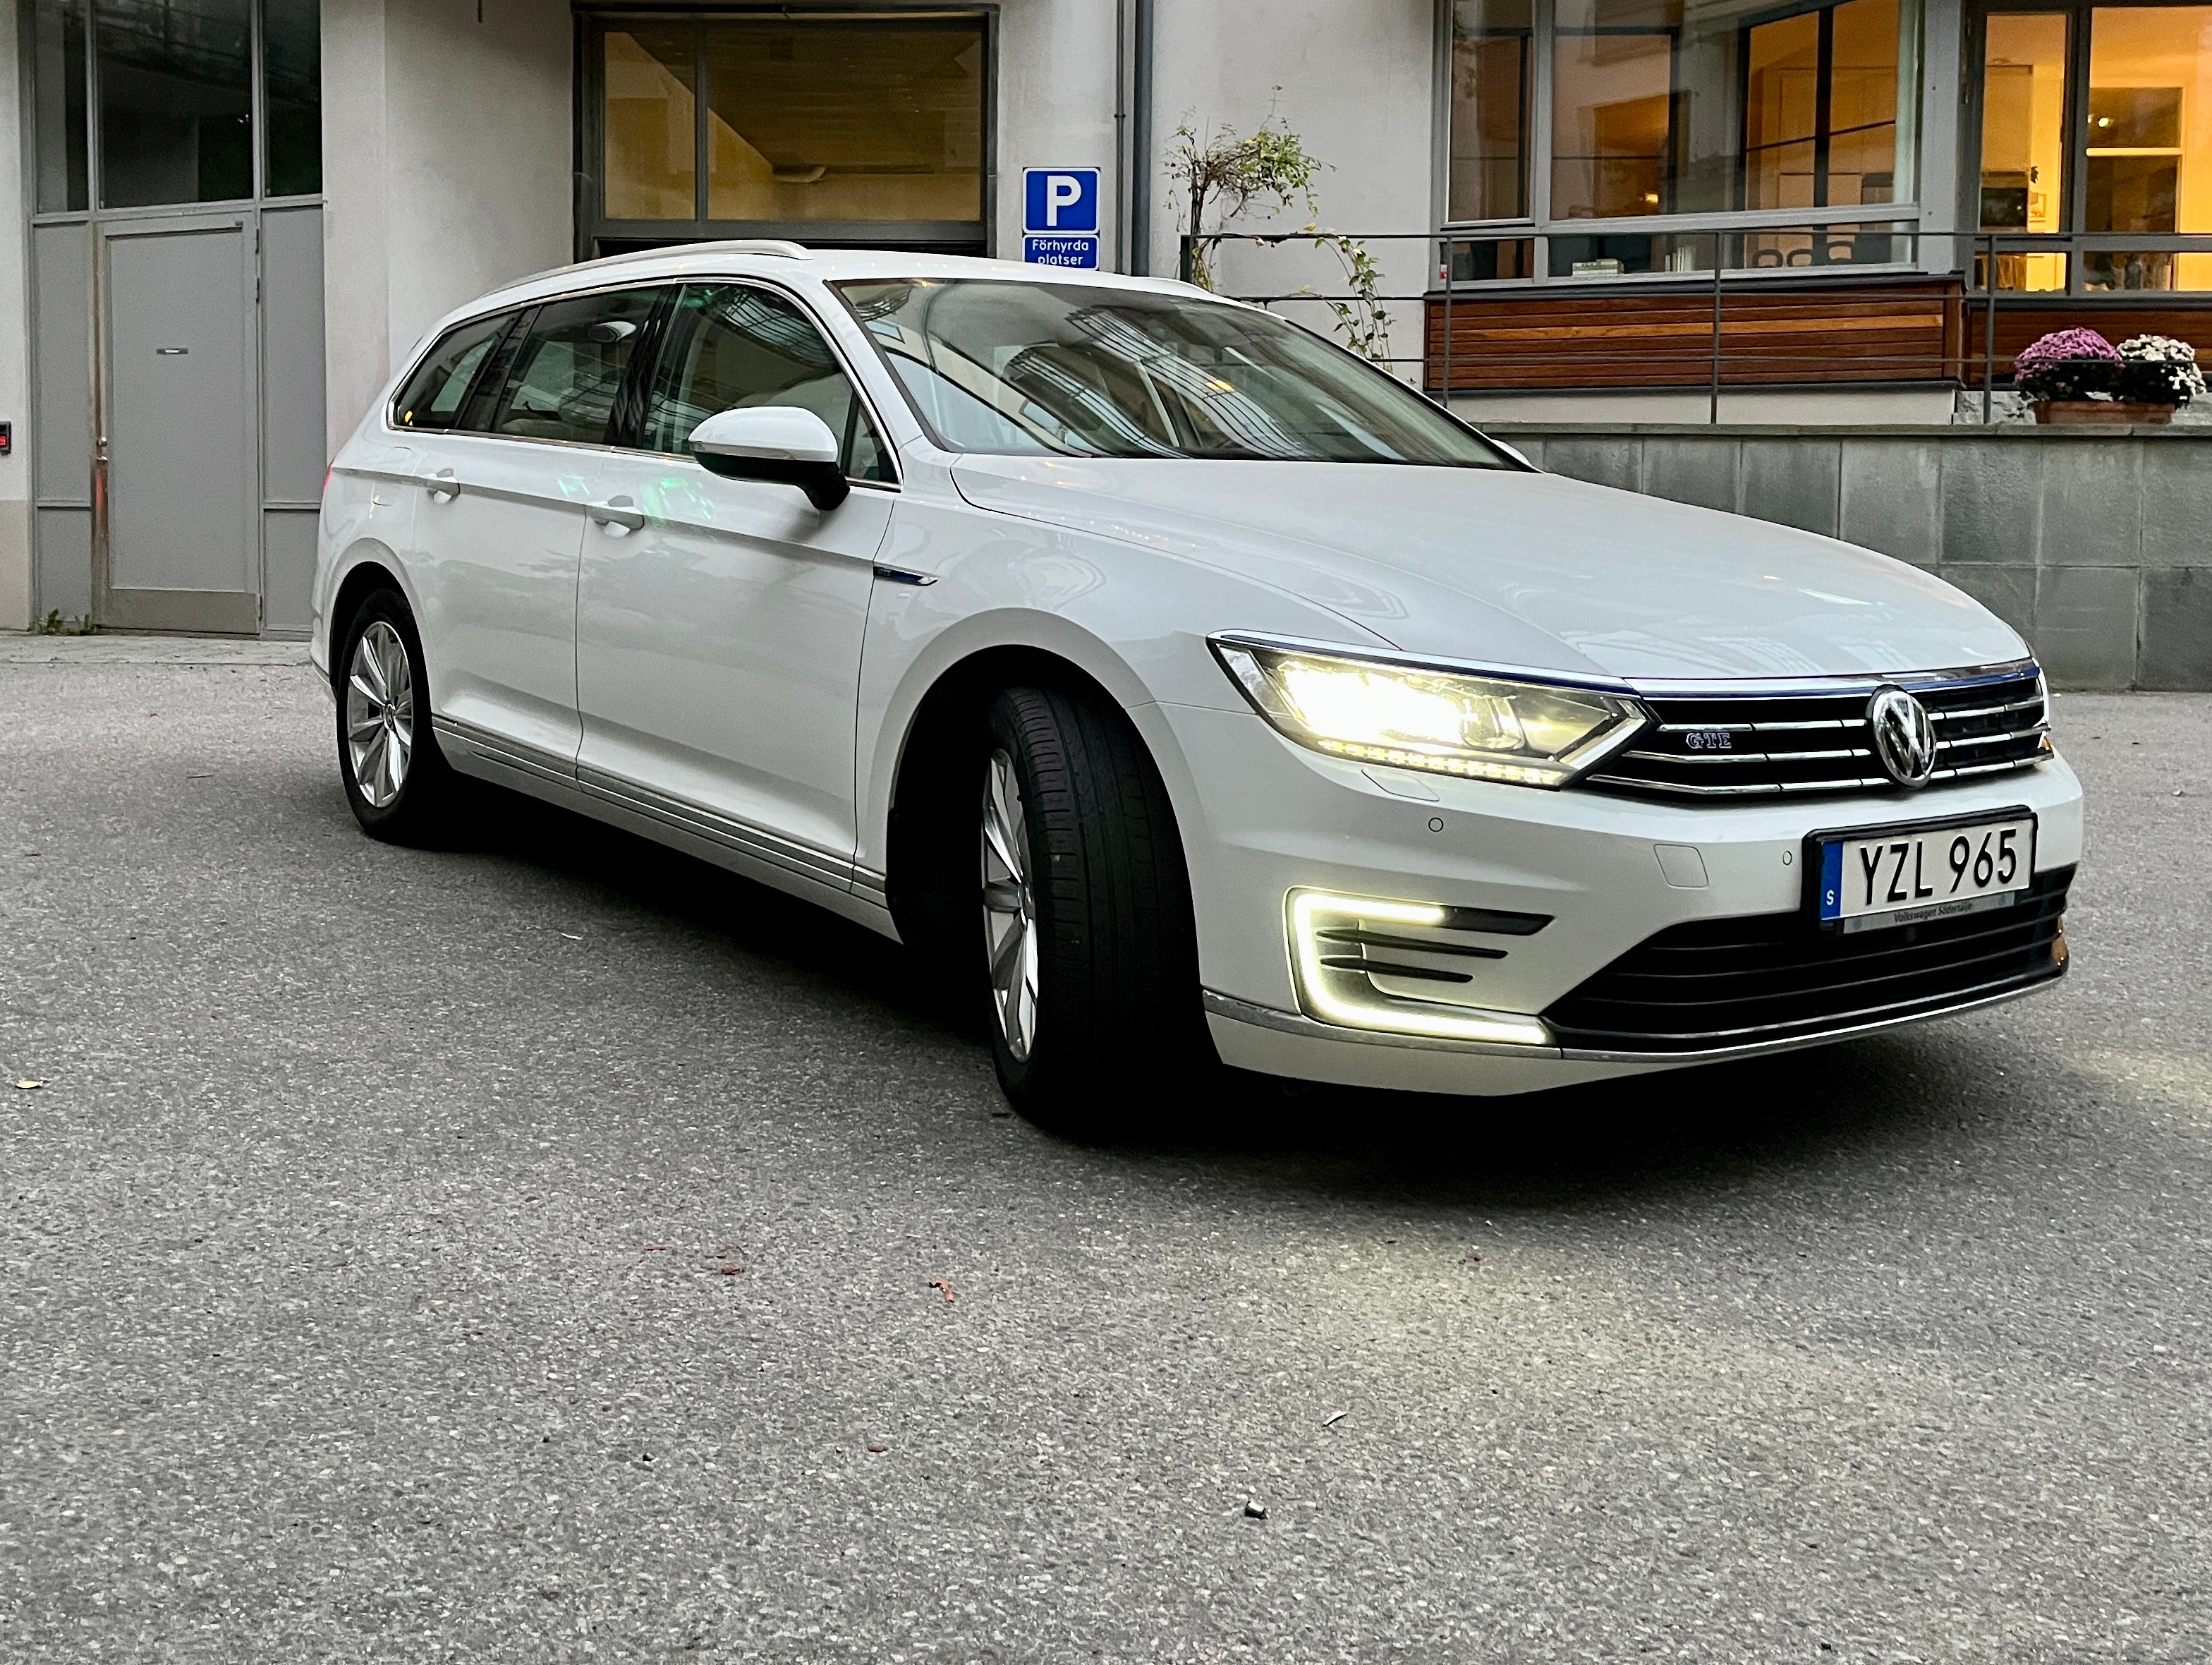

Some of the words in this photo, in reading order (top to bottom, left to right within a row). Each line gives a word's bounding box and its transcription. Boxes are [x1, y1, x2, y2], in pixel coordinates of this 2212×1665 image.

[1047, 175, 1081, 226] P
[1032, 239, 1089, 253] Förhyrda
[1686, 732, 1732, 749] GTE
[1860, 840, 1933, 906] YZL
[1949, 828, 2017, 893] 965
[1825, 890, 1835, 906] S
